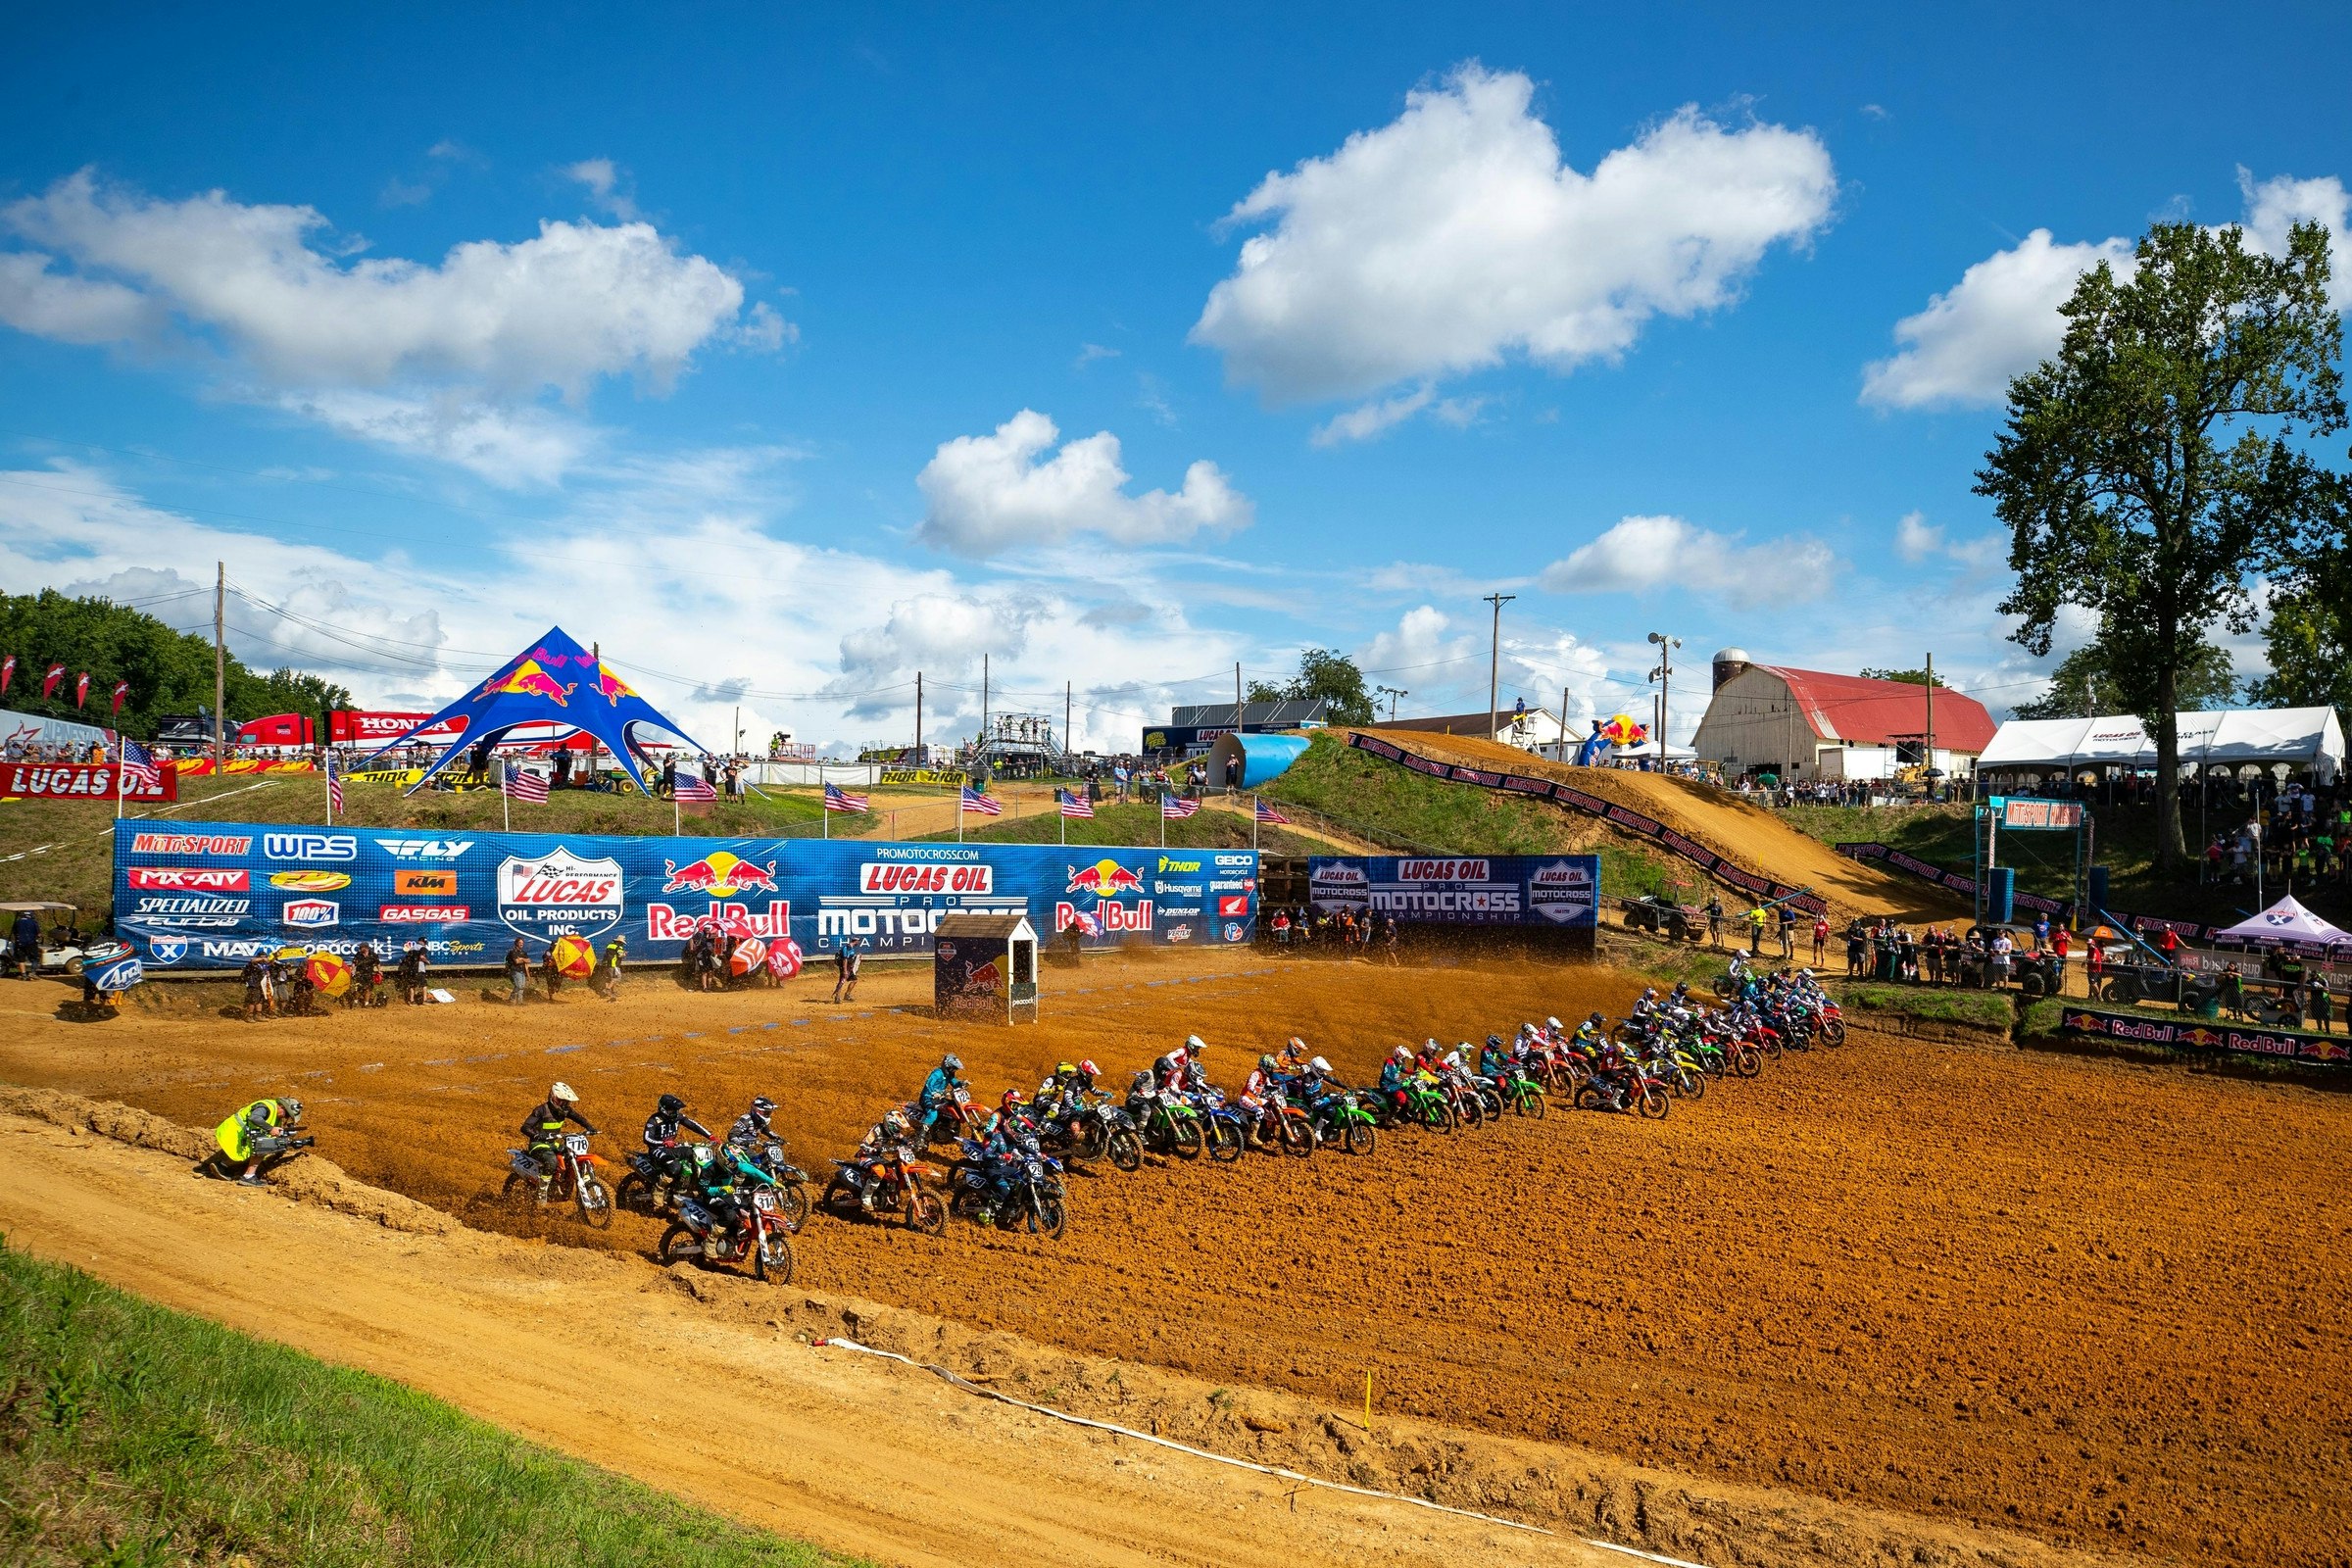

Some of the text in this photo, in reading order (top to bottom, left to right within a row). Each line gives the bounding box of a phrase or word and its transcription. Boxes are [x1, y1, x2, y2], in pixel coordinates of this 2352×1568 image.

[11, 767, 111, 796] LUCAS
[364, 770, 410, 782] THOR
[265, 833, 358, 860] WPS
[374, 839, 475, 857] FLY
[877, 849, 978, 859] PROMOTOCROSS.COM
[1214, 855, 1253, 865] GEICO
[1168, 861, 1200, 872] THOR
[1401, 860, 1488, 880] LUCAS OIL
[407, 875, 446, 888] KTM
[866, 865, 988, 892] LUCAS OIL
[1319, 870, 1359, 881] LUCAS OIL
[1540, 871, 1583, 882] LUCAS OIL
[514, 880, 615, 903] LUCAS
[1164, 883, 1202, 894] Husqvarna
[1209, 879, 1244, 892] guaranteed
[1311, 887, 1368, 897] MOTOCROSS
[1532, 890, 1591, 899] MOTOCROSS
[134, 898, 251, 913] SPECIALIZED
[900, 897, 956, 906] PRO
[1370, 892, 1519, 911] MOTOCROSS
[291, 906, 331, 920] 100%
[383, 908, 466, 920] GASGAS
[506, 909, 617, 921] OIL PRODUCTS
[549, 924, 579, 936] INC.
[160, 944, 178, 957] X
[449, 940, 486, 953] Sports
[2112, 1019, 2174, 1042] Red Bull
[2229, 1033, 2295, 1055] Red Bull
[661, 1121, 680, 1135] FLY
[568, 1139, 588, 1151] 778
[1031, 1165, 1042, 1176] 29
[970, 1176, 984, 1186] 29
[758, 1196, 775, 1208] 314
